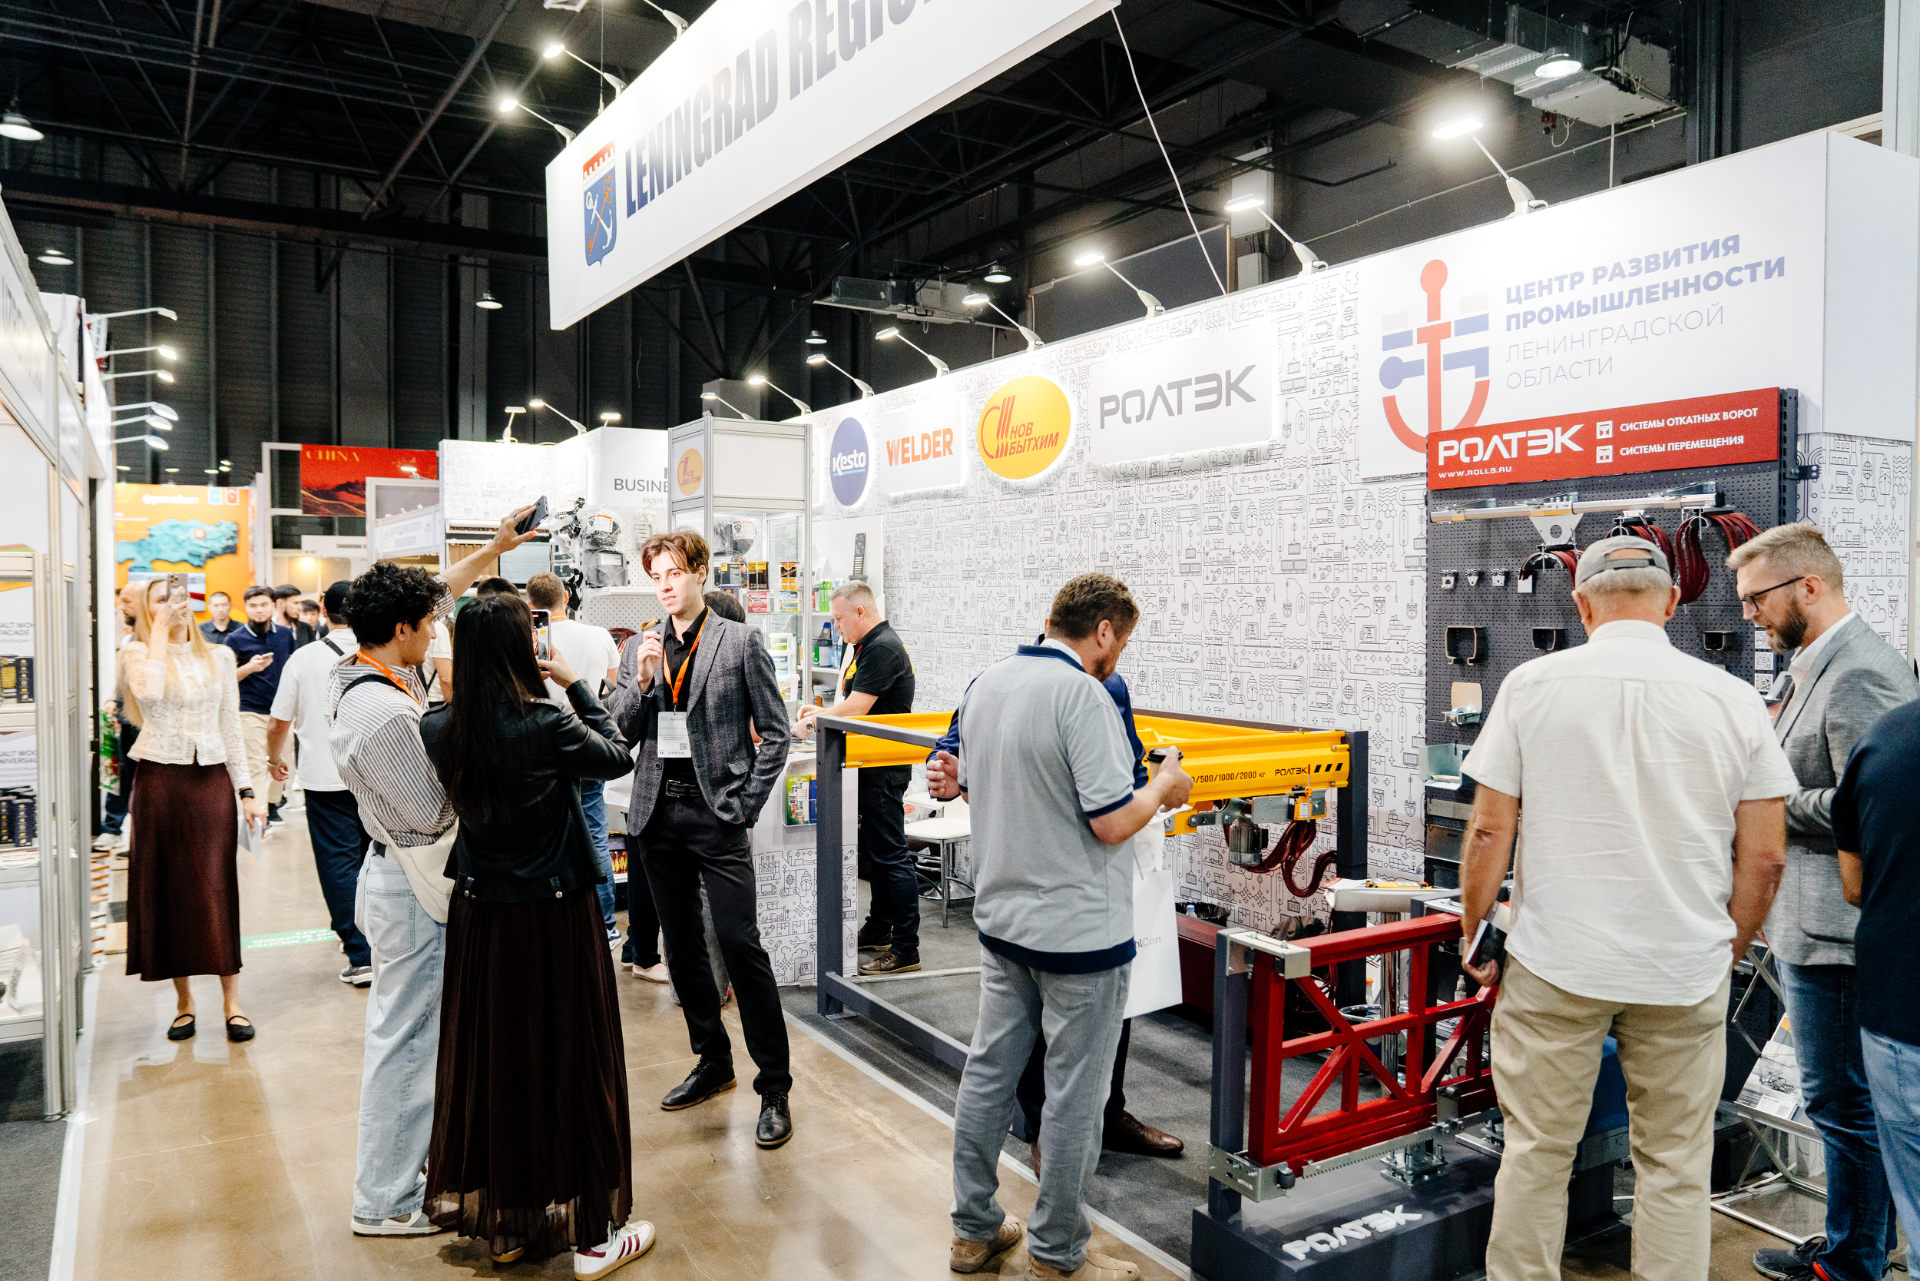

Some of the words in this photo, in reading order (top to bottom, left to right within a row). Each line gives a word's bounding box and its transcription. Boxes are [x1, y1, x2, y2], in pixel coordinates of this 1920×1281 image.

[625, 29, 779, 219] LENINGRAD
[788, 0, 932, 101] REG
[1506, 271, 1585, 305] ЦЕНТР
[1592, 234, 1740, 285] РАЗВИТИЯ
[1506, 256, 1785, 331] ПРОМЫШЛЕННОСТИ
[1505, 302, 1724, 363] ЛЕНИНГРАДСКОЙ
[1506, 356, 1613, 389] ОБЛАСТИ
[1099, 364, 1258, 430] РОЛТЭК
[1010, 421, 1034, 440] НОВ
[1620, 418, 1665, 432] СИСТЕМЫ
[1666, 412, 1720, 427] ОТКАТНЫХ
[1722, 407, 1758, 421] ВОРОТ
[305, 449, 360, 462] CHINA
[886, 427, 953, 466] WELDER
[1008, 432, 1060, 456] БЫТХИМ
[1438, 424, 1584, 466] РОЛТЭК
[1619, 442, 1665, 457] СИСТЕМЫ
[1667, 435, 1744, 452] ПЕРЕМЕЩЕНИЯ
[832, 449, 867, 476] Kesto
[1438, 466, 1512, 479] WWW.ROLLS.RU
[613, 478, 669, 493] BUSINE
[642, 497, 664, 505] export
[1275, 766, 1308, 776] РОЛТЭК
[1133, 936, 1162, 949] hlCon
[1282, 1204, 1423, 1262] РОЛТЭК
